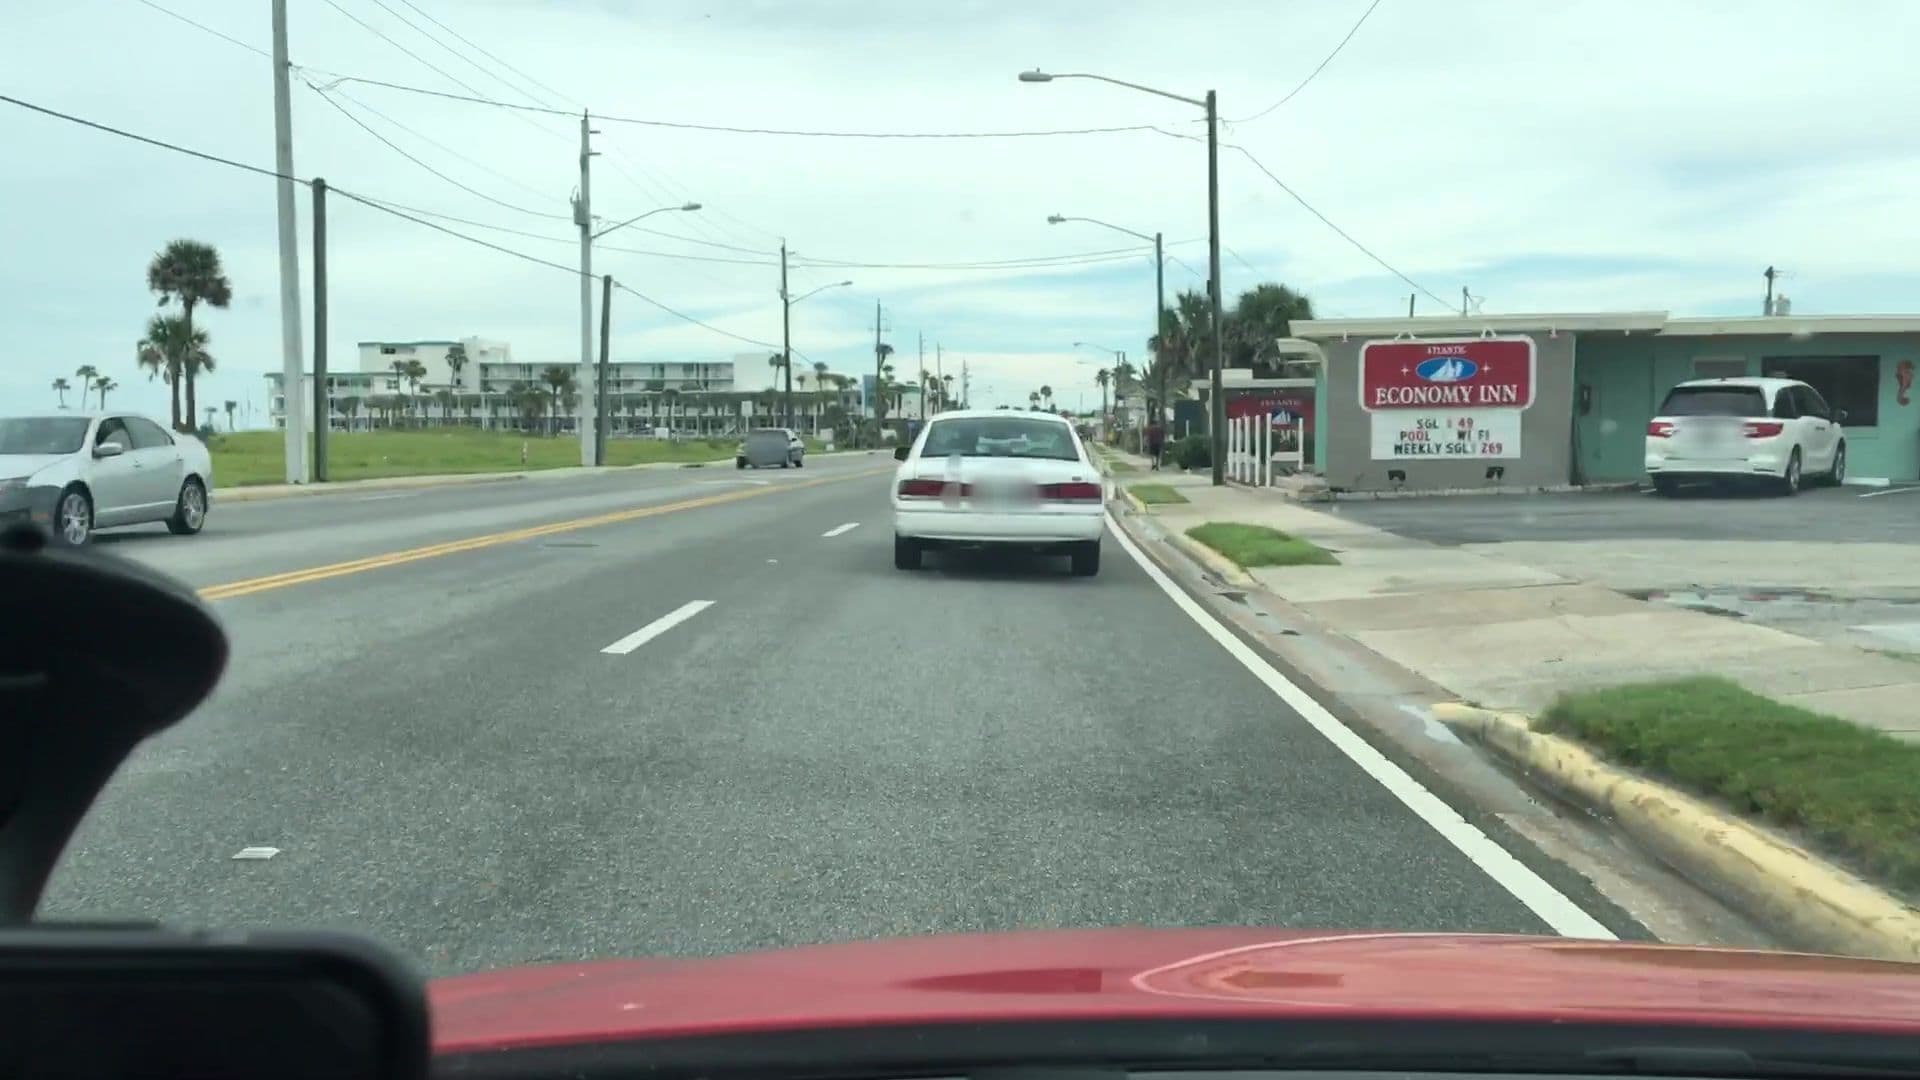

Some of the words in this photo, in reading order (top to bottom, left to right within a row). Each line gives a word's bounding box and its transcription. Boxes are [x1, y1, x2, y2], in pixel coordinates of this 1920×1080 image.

[1375, 386, 1473, 405] ECONOMY
[1480, 384, 1517, 402] INN
[1416, 418, 1439, 430] SGL
[1400, 430, 1431, 442] POOL
[1457, 430, 1471, 442] WI
[1478, 430, 1490, 441] FI
[1394, 443, 1442, 456] WEEKLY
